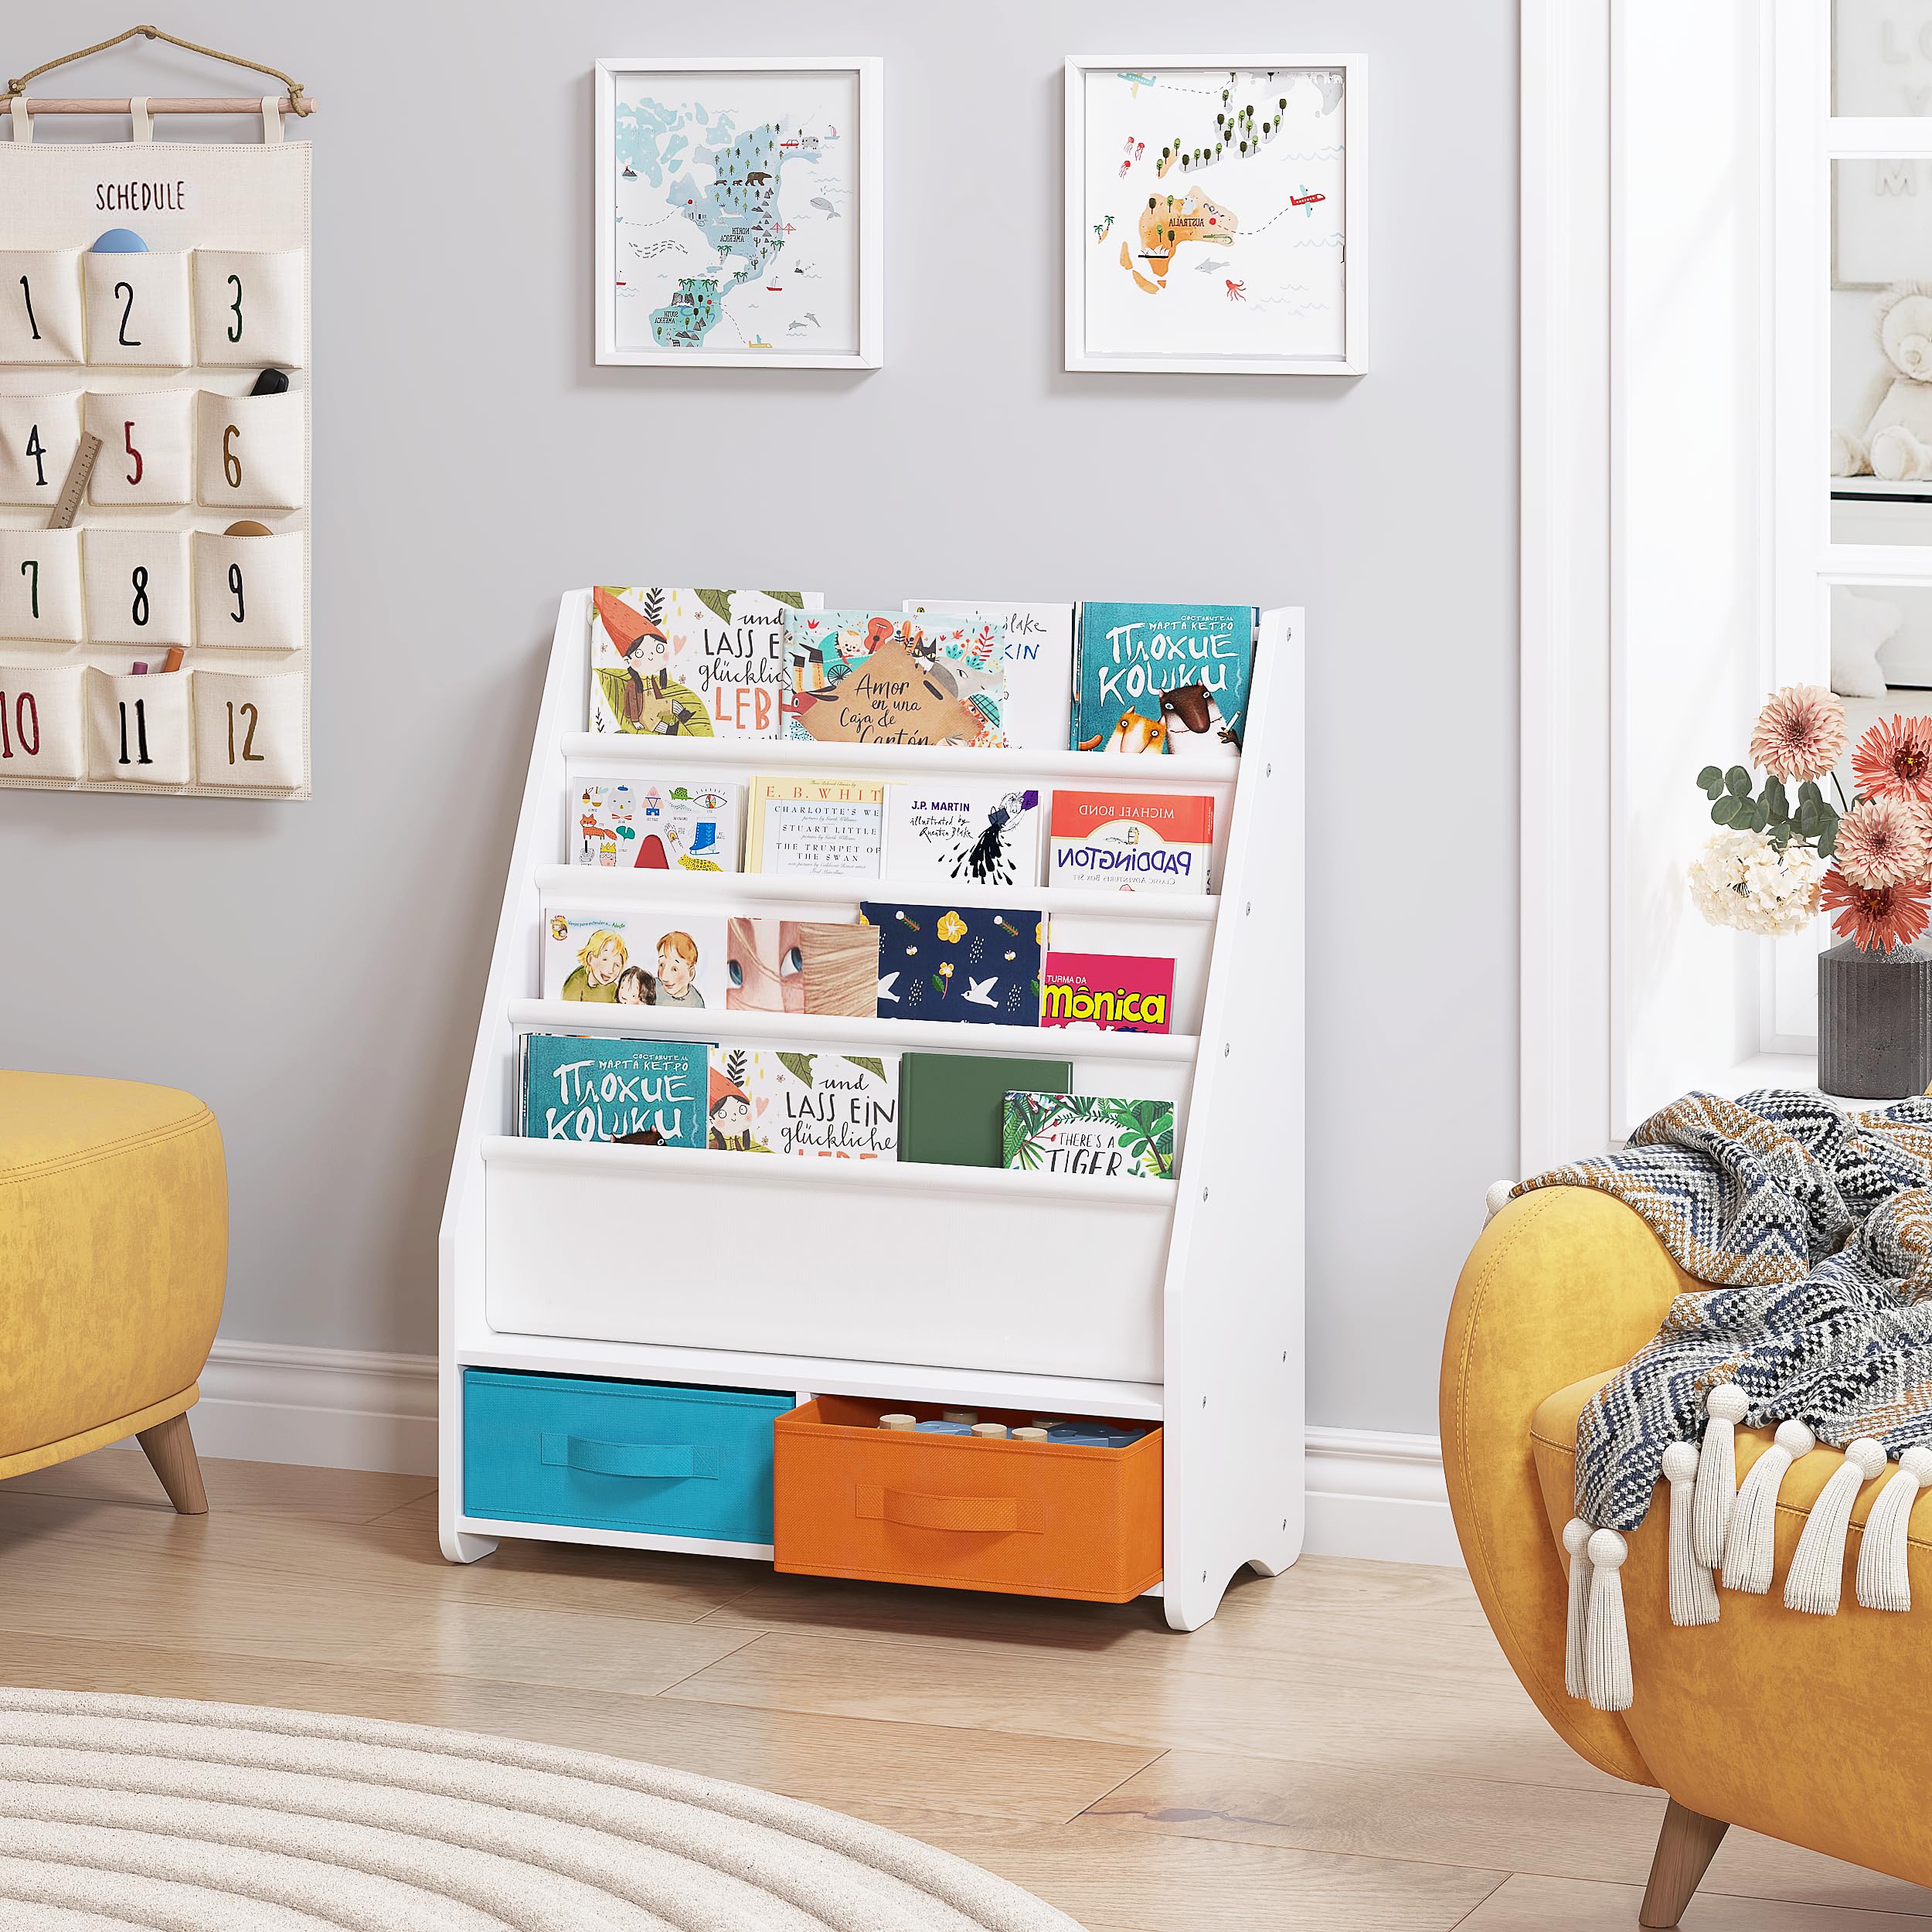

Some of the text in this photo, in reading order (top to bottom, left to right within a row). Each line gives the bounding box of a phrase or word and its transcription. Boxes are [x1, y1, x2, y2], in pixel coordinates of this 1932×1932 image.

[96, 180, 185, 211] SCHEDULE
[19, 275, 42, 340] 1
[114, 281, 142, 346] 2
[226, 274, 243, 343] 3
[26, 423, 48, 486] 4
[124, 420, 144, 485] 5
[223, 423, 243, 488] 6
[21, 560, 39, 618] 7
[131, 566, 149, 626] 8
[228, 563, 245, 623] 9
[737, 607, 784, 625] und
[1004, 613, 1047, 635] lake
[1149, 621, 1234, 631] МАРТА КЕТРО
[703, 628, 754, 658] LASS
[854, 672, 910, 699] Amor
[715, 686, 782, 730] LEB
[839, 707, 896, 728] Caja de
[870, 699, 922, 712] en una
[0, 690, 40, 759] 10
[118, 698, 154, 764] 11
[226, 701, 265, 765] 12
[774, 806, 857, 816] CHARLOTTE'S
[910, 816, 954, 825] illustrated
[911, 801, 971, 812] J.P. MARTIN
[782, 824, 877, 835] STUART LITTLE
[919, 826, 949, 843] Quentin
[804, 843, 860, 853] TRUMPET
[1046, 975, 1087, 985] TURMA DA
[598, 1060, 689, 1071] МАРТА КЕТРО
[819, 1073, 869, 1091] und
[785, 1091, 835, 1122] LASS
[1058, 1131, 1115, 1149] THERE'S A
